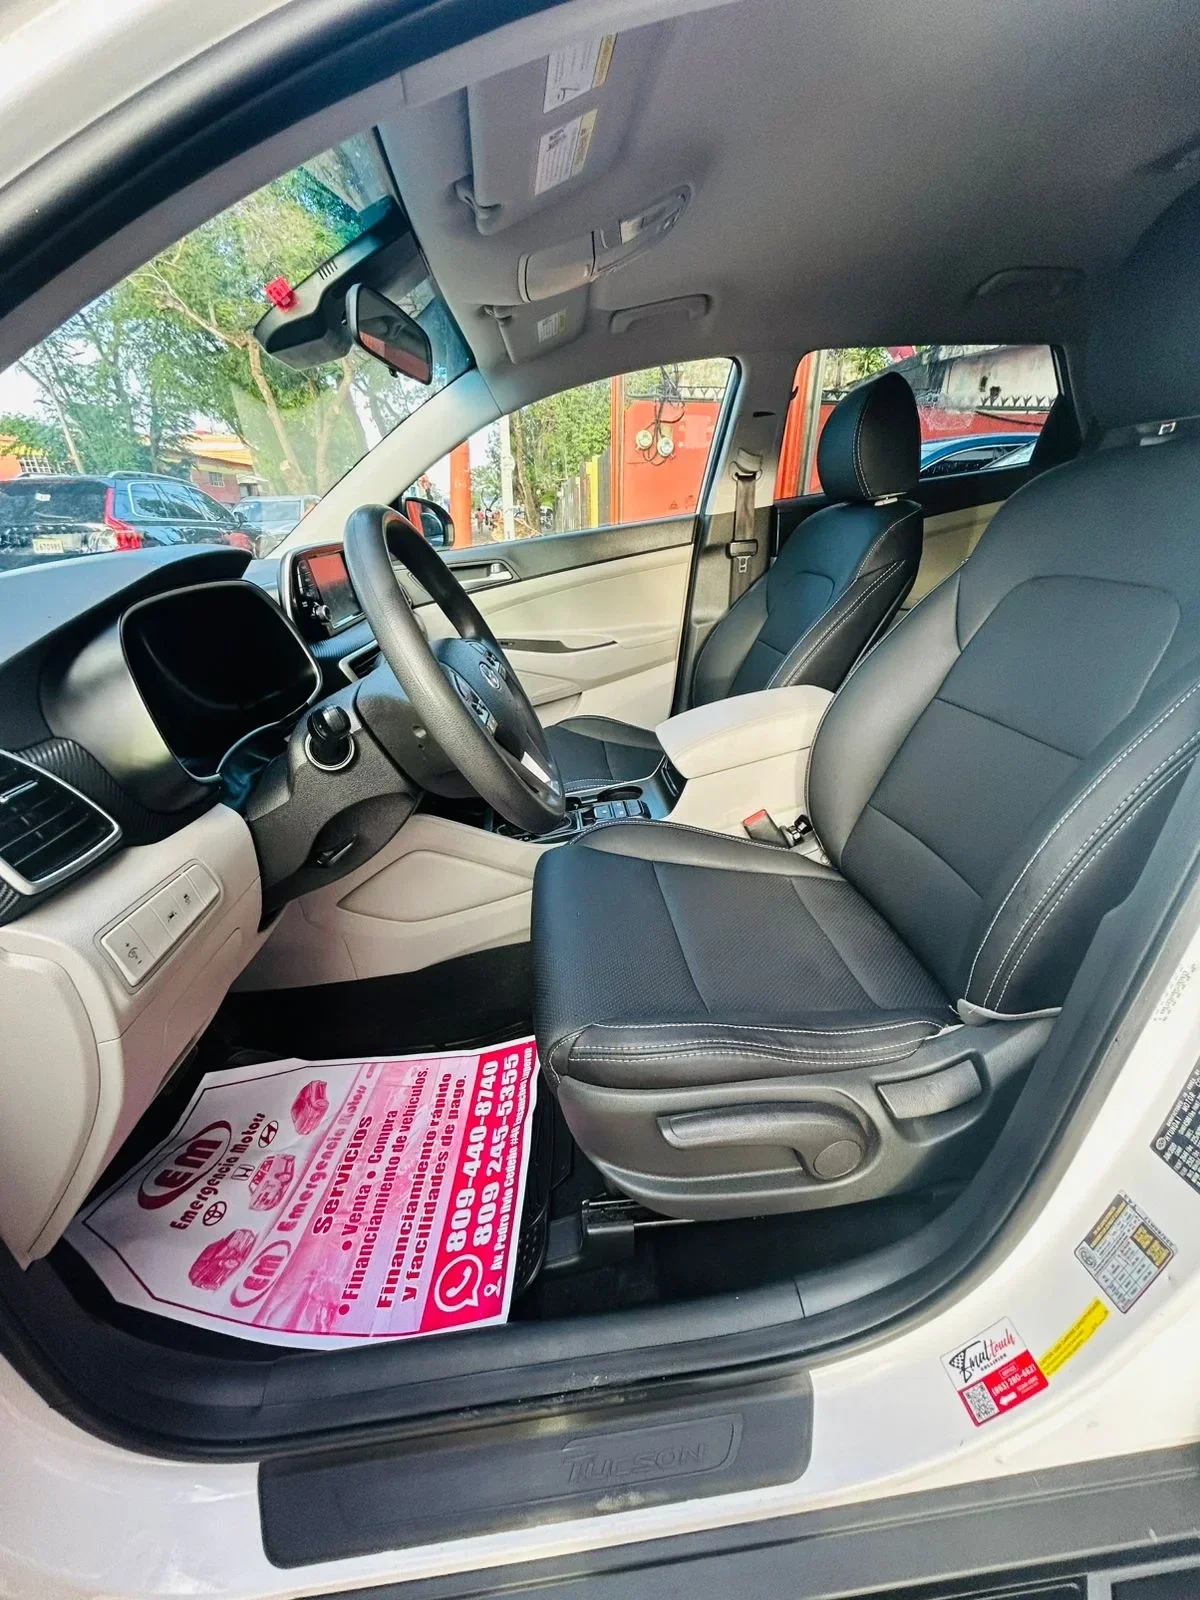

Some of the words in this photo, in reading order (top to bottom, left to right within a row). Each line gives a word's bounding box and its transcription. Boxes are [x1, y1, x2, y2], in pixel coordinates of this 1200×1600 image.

[440, 1124, 455, 1147] de
[448, 1075, 467, 1119] pago.
[486, 1053, 519, 1177] 245-5355
[1164, 1116, 1181, 1141] HYUNDAI
[1181, 1091, 1195, 1111] MOTOR
[170, 1156, 239, 1230] Emergencia
[230, 1113, 266, 1153] Motors
[277, 1128, 346, 1232] Emergencia
[313, 1116, 373, 1234] Servicios
[342, 1184, 372, 1236] Venta
[368, 1111, 398, 1164] Compra
[377, 1130, 437, 1308] Financiamiento
[430, 1073, 452, 1127] rápido
[446, 1060, 499, 1252] 809-440-8740
[342, 1156, 400, 1300] Financiamiento
[392, 1135, 407, 1153] de
[406, 1151, 449, 1281] facilidades
[473, 1181, 500, 1247] 809
[491, 1251, 505, 1270] Av.
[494, 1214, 510, 1251] Pedro
[402, 1286, 417, 1302] y
[563, 1444, 705, 1484] TUCSON
